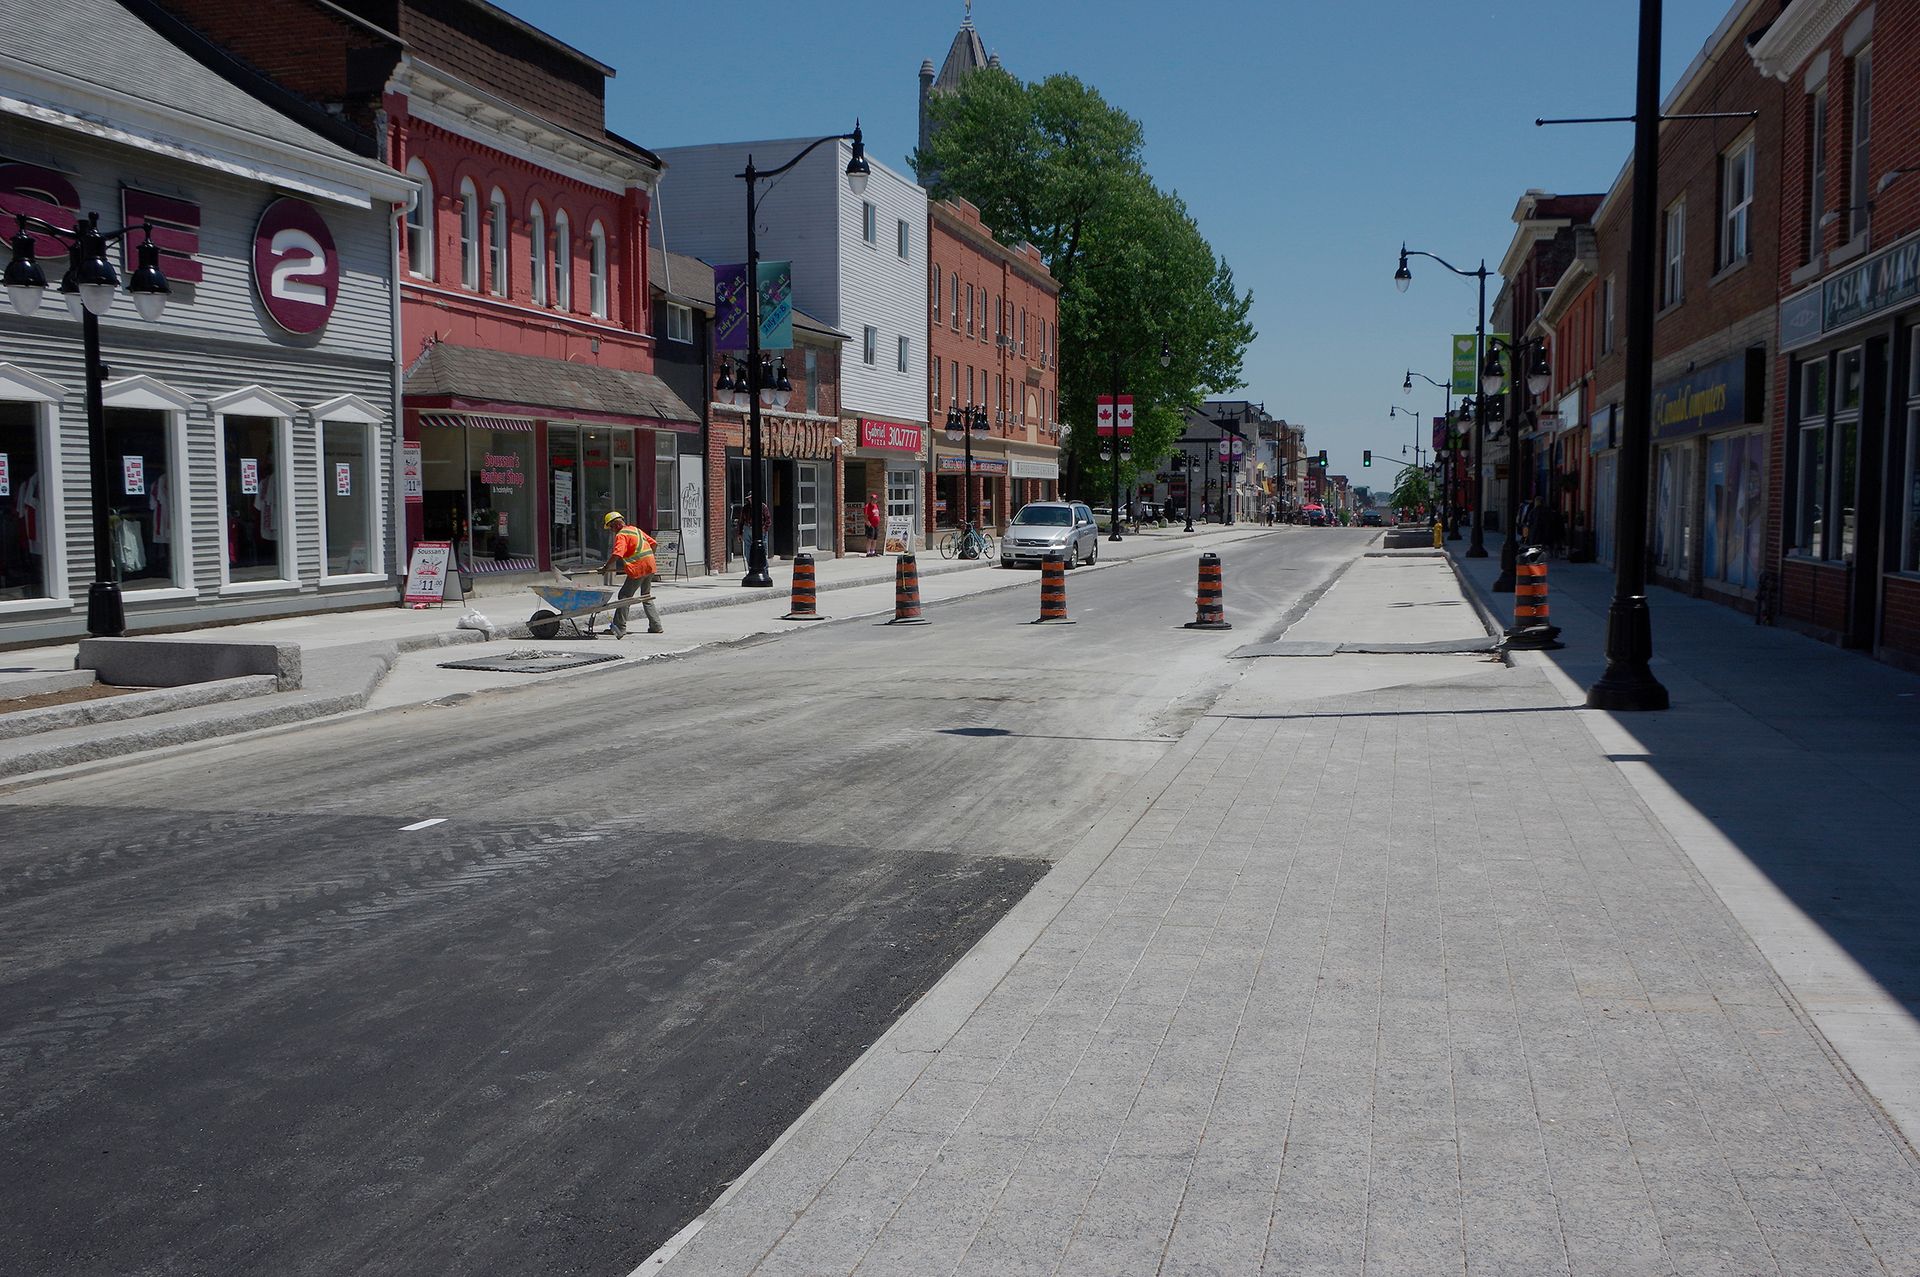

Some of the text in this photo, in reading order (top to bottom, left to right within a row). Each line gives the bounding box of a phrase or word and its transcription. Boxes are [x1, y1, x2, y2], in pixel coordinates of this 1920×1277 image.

[270, 227, 327, 306] 2
[1830, 264, 1873, 313] ASIAN
[763, 317, 776, 332] July
[865, 421, 886, 441] Gabriel
[484, 451, 521, 468] Soussan's
[480, 468, 525, 489] Barber Shop
[687, 508, 697, 516] WE
[682, 517, 702, 528] TRUST
